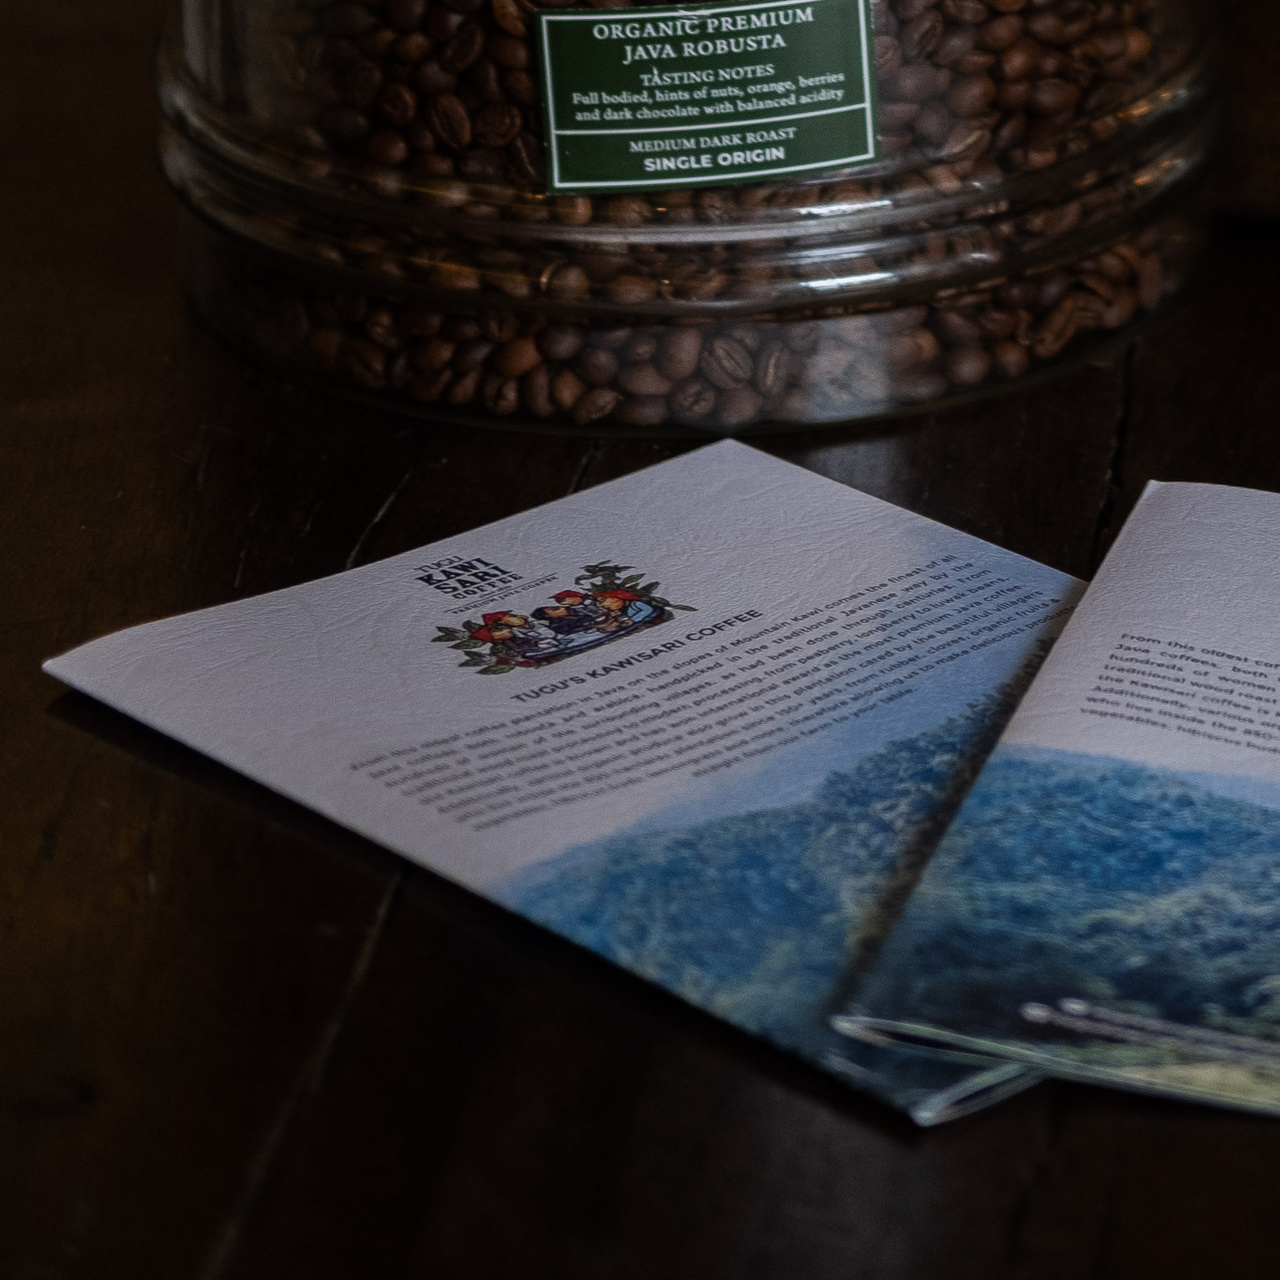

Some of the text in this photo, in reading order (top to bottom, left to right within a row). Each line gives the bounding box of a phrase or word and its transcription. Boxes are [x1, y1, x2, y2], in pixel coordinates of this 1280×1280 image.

[592, 7, 814, 40] ORGANIC PREMIUM
[623, 33, 787, 64] JAVA ROBUSTA
[572, 71, 845, 105] Full bodied, hints of nuts, orange, berries
[639, 64, 775, 86] TASTING NOTES
[575, 88, 845, 121] and dark chocolate with balanced acidity
[630, 127, 797, 153] MEDIUM DARK ROAST
[644, 146, 785, 171] SINGLE ORIGIN
[414, 555, 466, 573] TUGU
[415, 557, 496, 586] KAWI
[434, 565, 513, 594] SARI
[452, 573, 524, 600] COFFEE
[671, 554, 958, 671] slopes of Mountain Kawi comes the finest of all
[725, 562, 974, 663] in the traditional Javanese way by the
[737, 659, 766, 672] had
[767, 645, 803, 661] been
[806, 630, 839, 646] done
[840, 609, 894, 631] through
[956, 569, 992, 584] From
[935, 590, 1044, 635] beautiful villagers
[763, 662, 798, 677] from
[854, 613, 917, 639] longberry
[914, 607, 932, 615] to
[928, 592, 969, 609] luwak
[837, 650, 863, 661] the
[863, 635, 898, 652] most
[896, 613, 954, 638] premium
[952, 601, 983, 614] Java
[511, 609, 764, 704] TUGU'S KAWISARI COFFEE
[1114, 643, 1151, 654] Java
[1231, 665, 1268, 679] both
[1120, 633, 1162, 645] From
[1167, 641, 1195, 652] this
[1200, 648, 1249, 663] oldest
